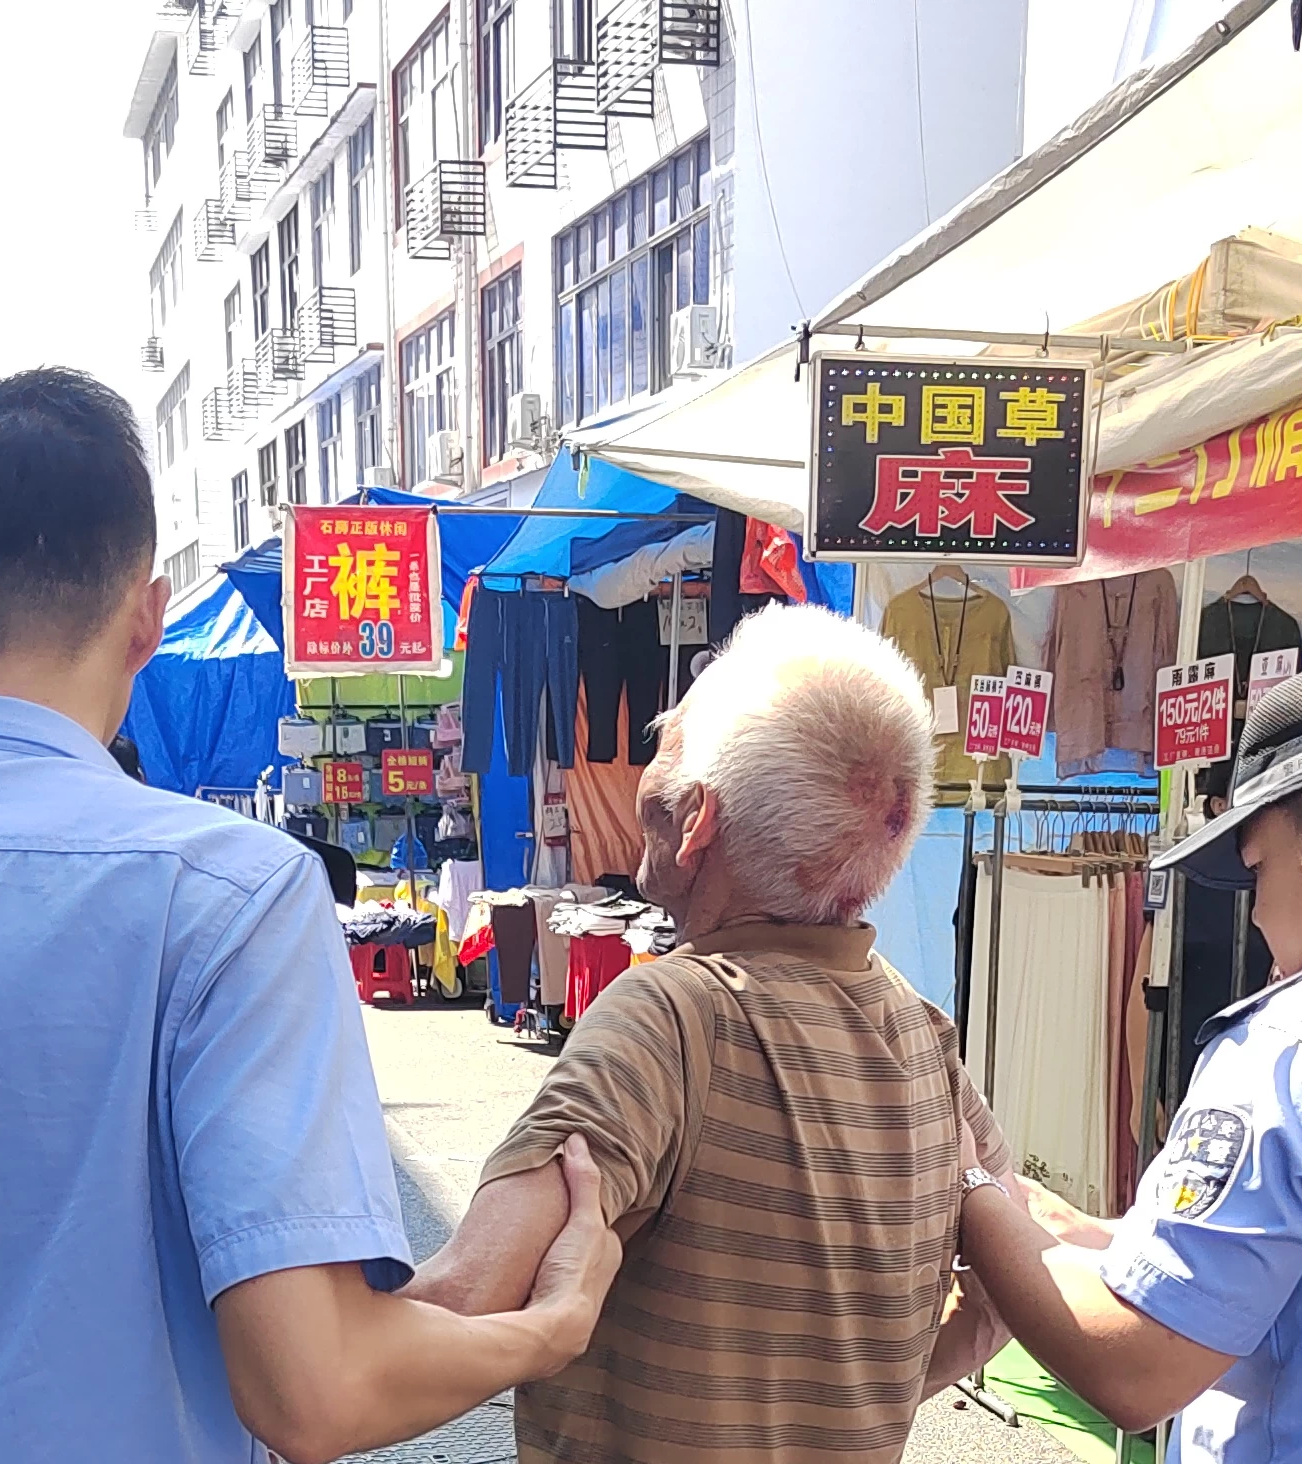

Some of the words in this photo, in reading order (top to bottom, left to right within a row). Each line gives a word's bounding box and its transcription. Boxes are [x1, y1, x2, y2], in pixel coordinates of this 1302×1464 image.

[842, 382, 1066, 446] 中国草
[858, 447, 1036, 538] 麻
[303, 555, 329, 619] 工厂店
[328, 542, 401, 621] 裤
[359, 620, 395, 658] 39
[1160, 685, 1226, 728] 150元/2件
